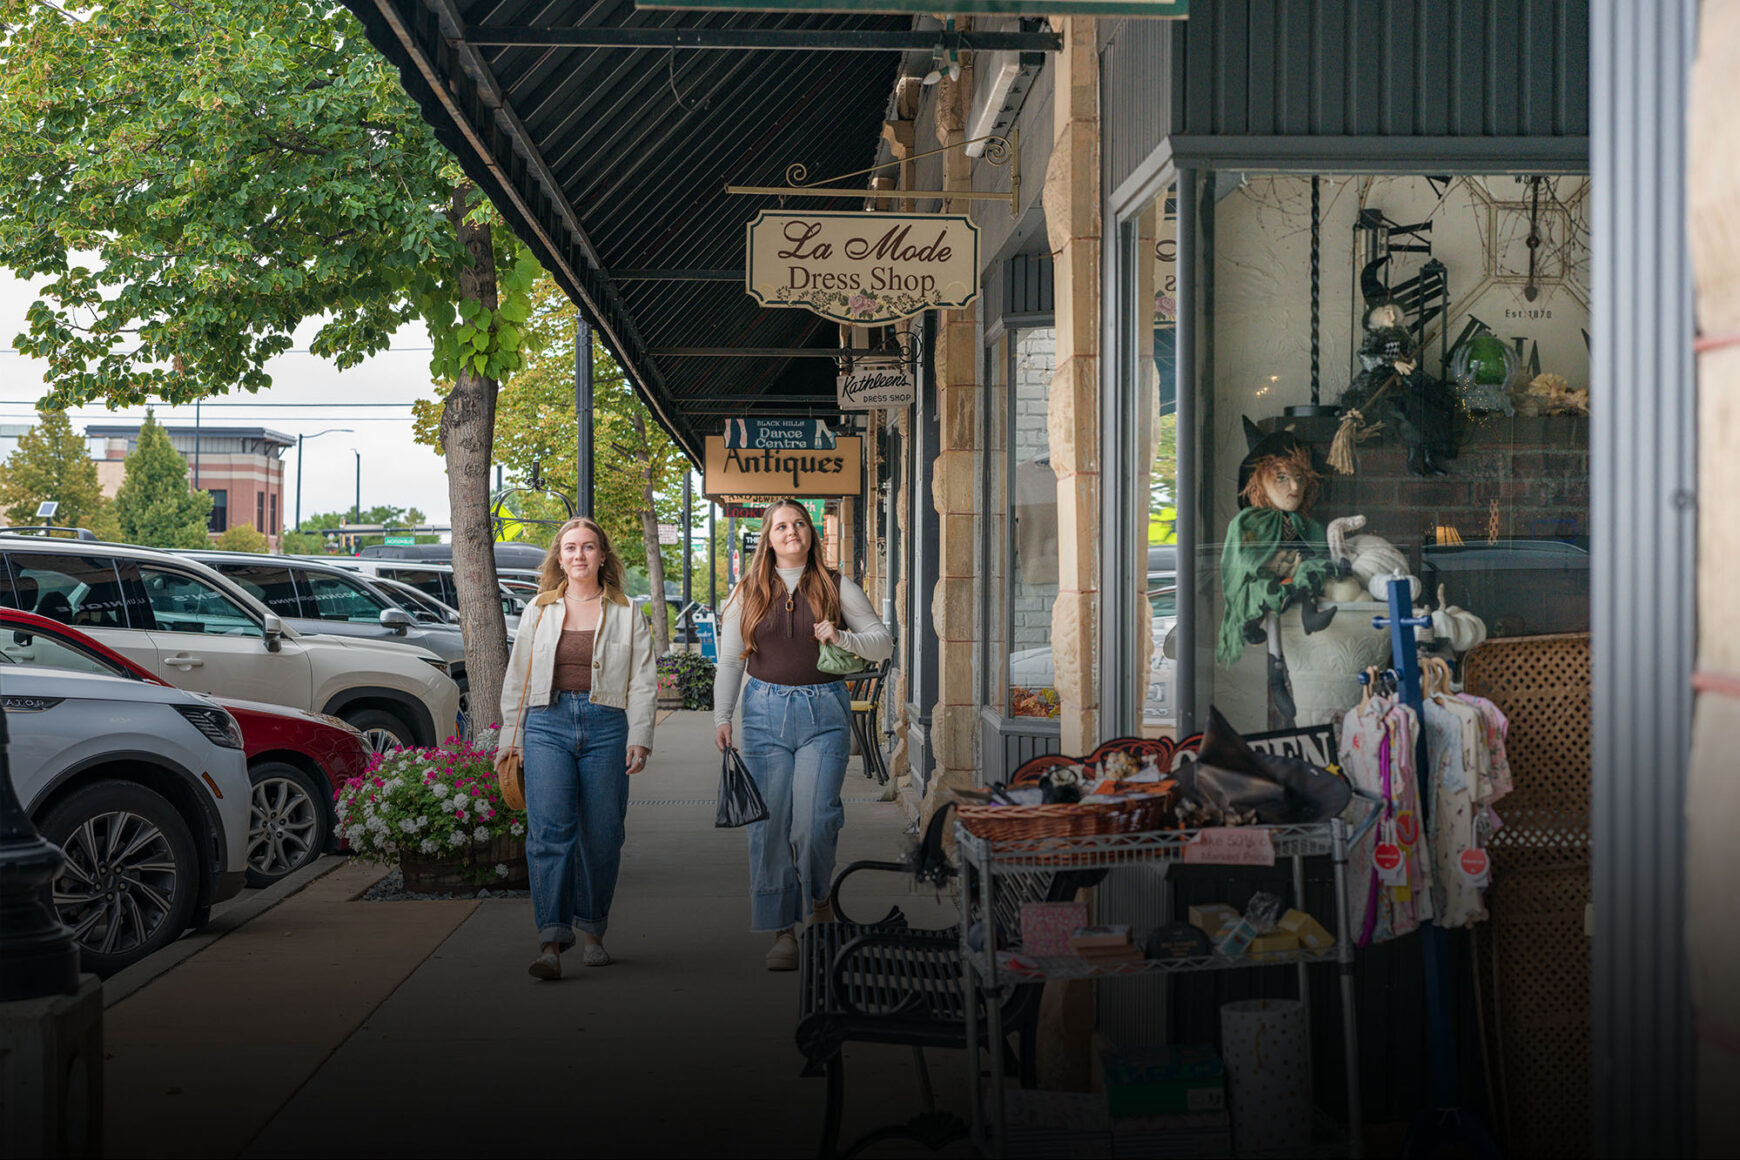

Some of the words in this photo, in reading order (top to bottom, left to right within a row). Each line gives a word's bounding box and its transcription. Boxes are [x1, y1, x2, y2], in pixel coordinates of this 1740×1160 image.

[778, 220, 833, 261] La
[844, 224, 952, 263] Mode
[788, 266, 861, 290] Dress
[870, 266, 935, 298] Shop
[842, 373, 912, 403] Kathleen's
[863, 394, 888, 403] DRESS
[889, 393, 912, 402] SHOP
[755, 438, 807, 449] Centre
[759, 427, 803, 439] Dance
[723, 448, 845, 489] Antiques
